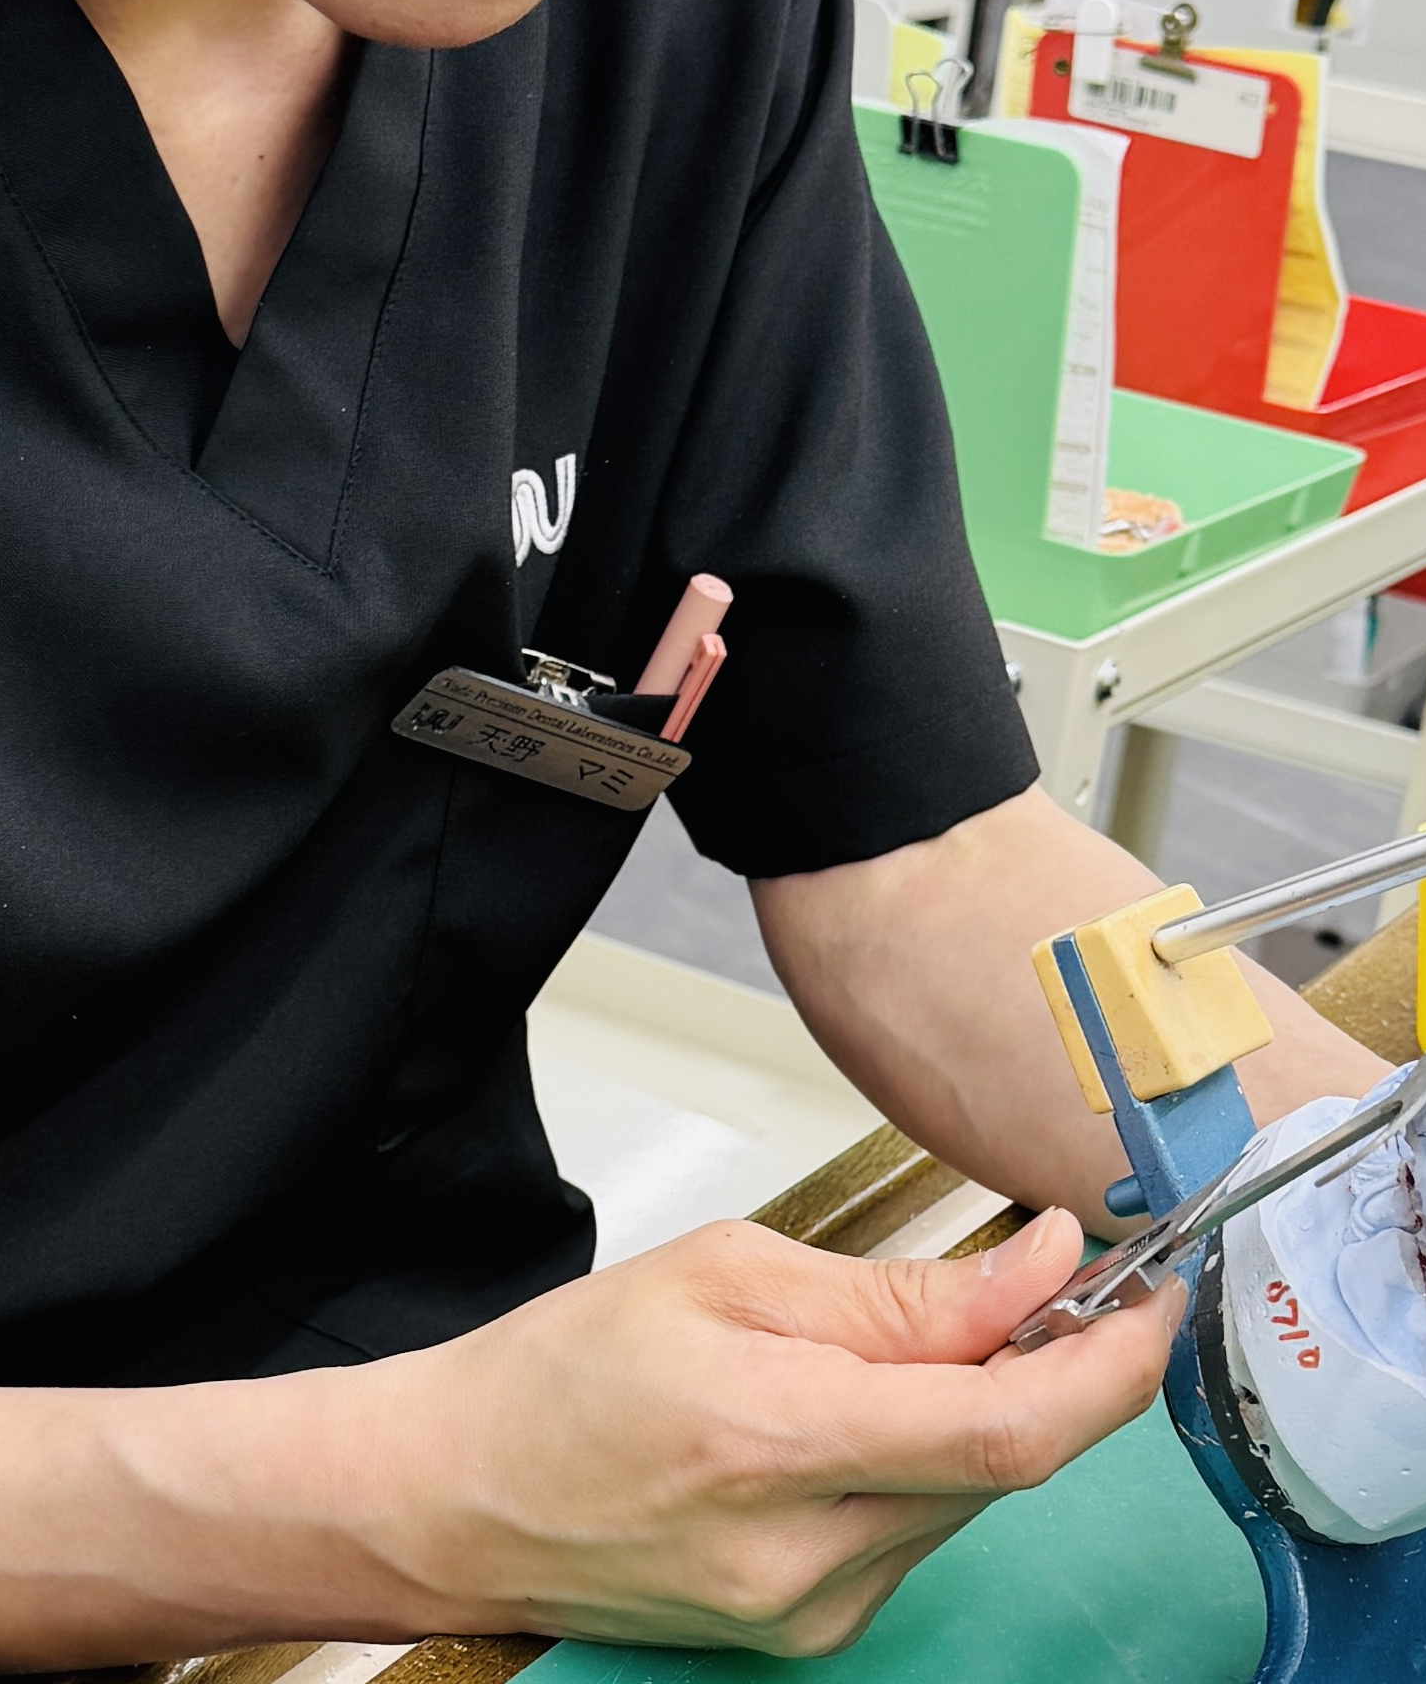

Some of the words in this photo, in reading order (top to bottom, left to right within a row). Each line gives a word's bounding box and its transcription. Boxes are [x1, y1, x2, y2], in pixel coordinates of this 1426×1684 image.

[526, 708, 569, 730] Dental
[566, 721, 636, 754] Laboratories
[579, 758, 634, 795] マミ
